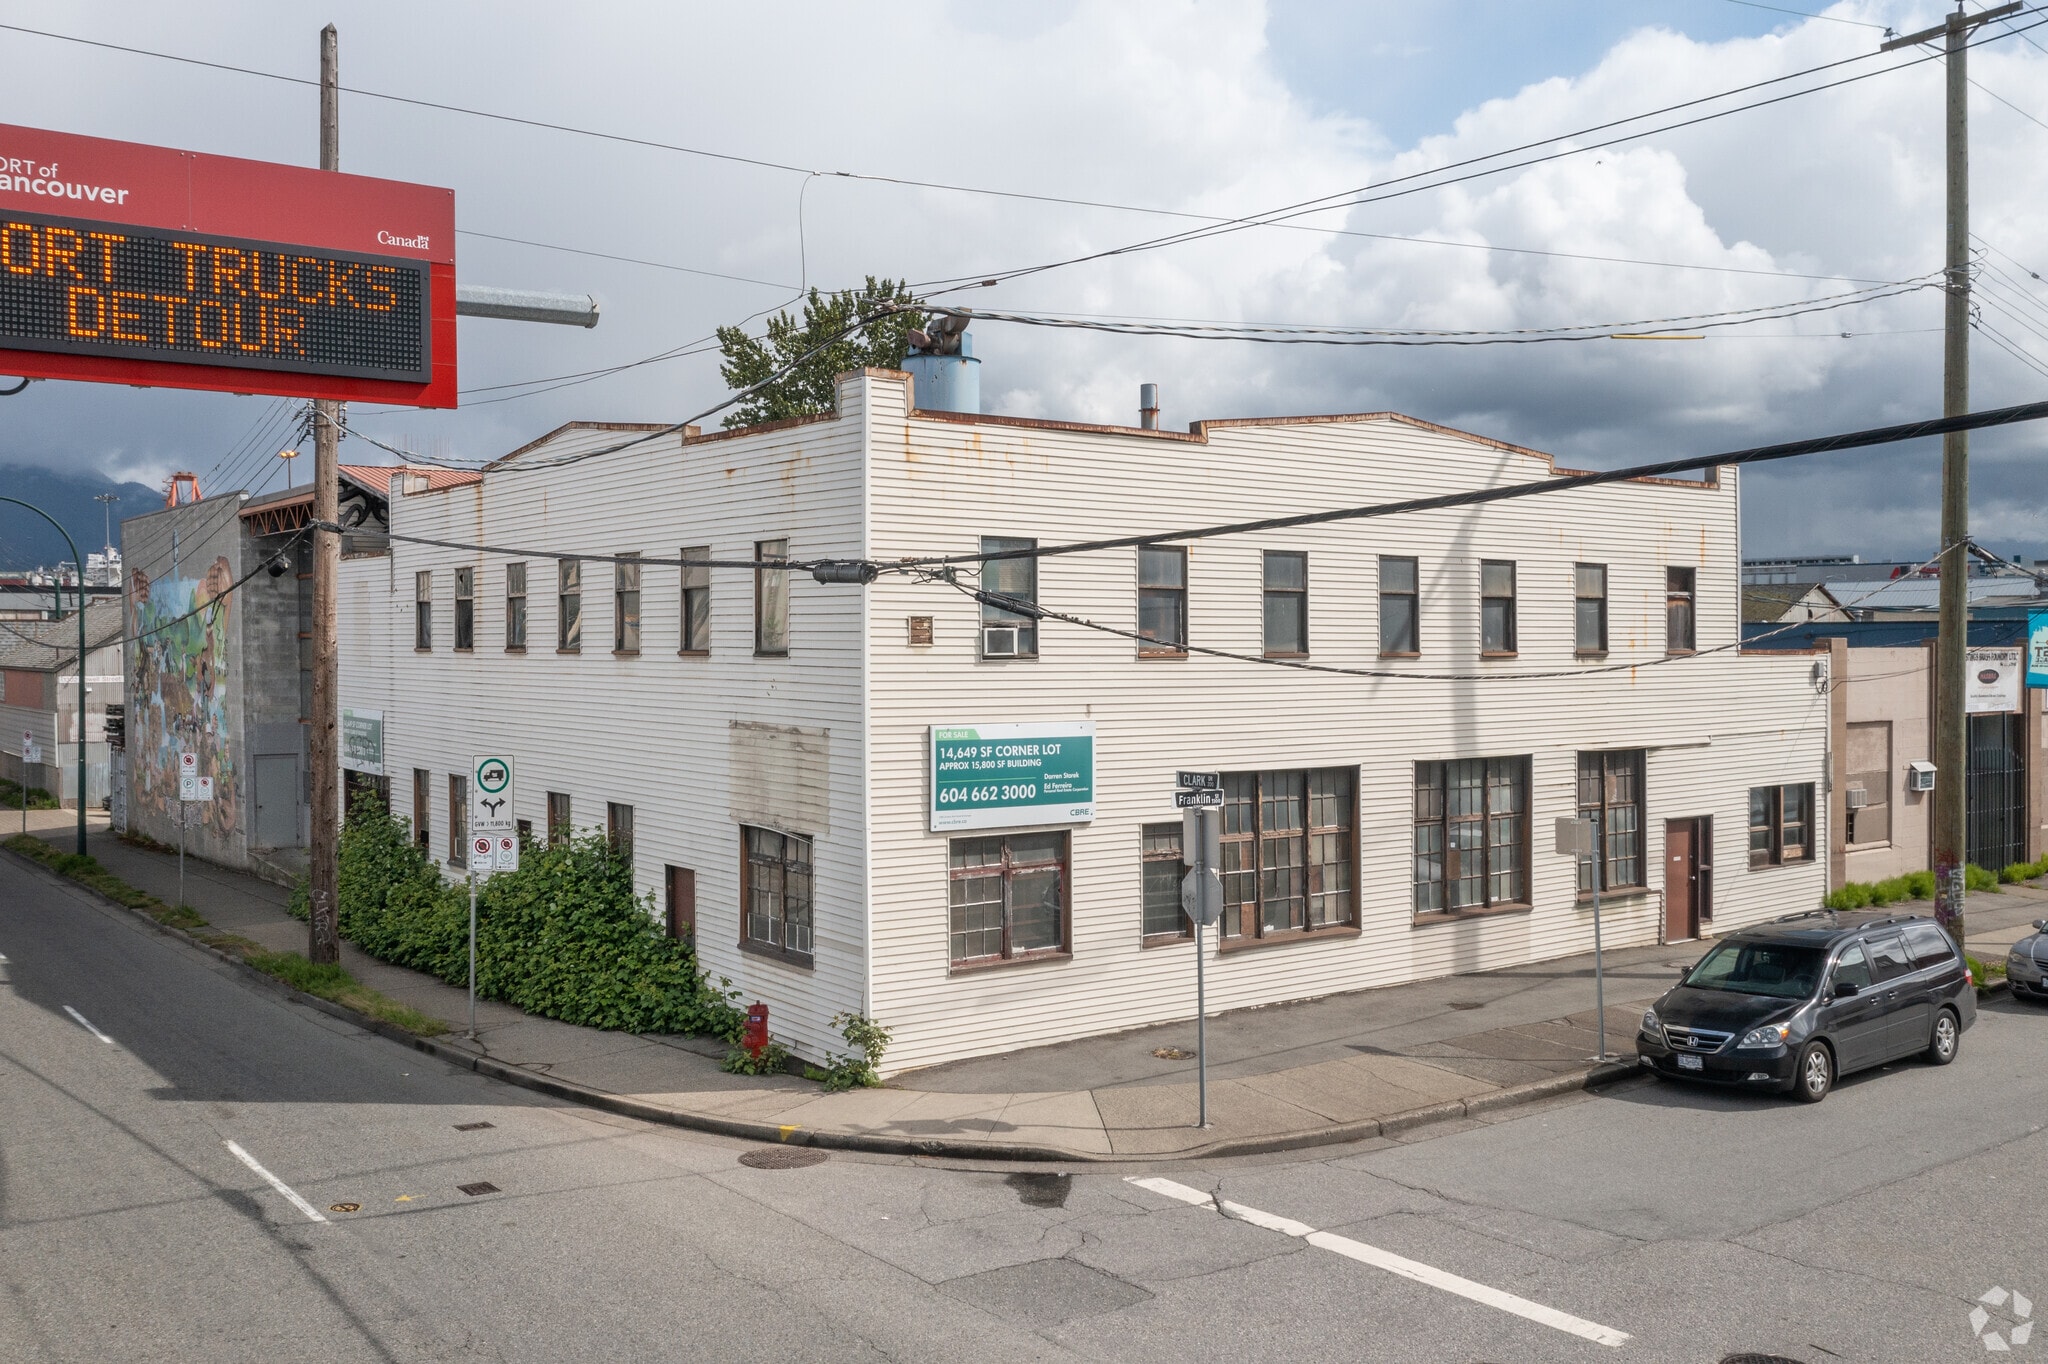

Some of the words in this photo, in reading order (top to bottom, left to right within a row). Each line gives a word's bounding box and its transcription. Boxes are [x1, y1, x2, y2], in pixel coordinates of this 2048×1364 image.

[39, 163, 58, 178] of
[377, 230, 429, 250] Canada
[172, 240, 397, 313] TRUCKS
[68, 286, 306, 356] DETOUR
[939, 731, 952, 739] FOR
[940, 746, 977, 760] 14,649
[980, 746, 993, 757] SF
[995, 744, 1040, 757] CORNER
[1042, 743, 1062, 755] LOT
[939, 761, 970, 770] APPROX
[972, 760, 995, 770] 15,800
[997, 760, 1006, 768] SF
[1007, 758, 1042, 768] BUILDING
[1183, 774, 1206, 787] CLARK
[940, 786, 968, 803] 604
[971, 785, 998, 801] 662
[1001, 784, 1036, 800] 3000
[1178, 793, 1211, 805] Franklin
[1070, 808, 1090, 816] CBRE
